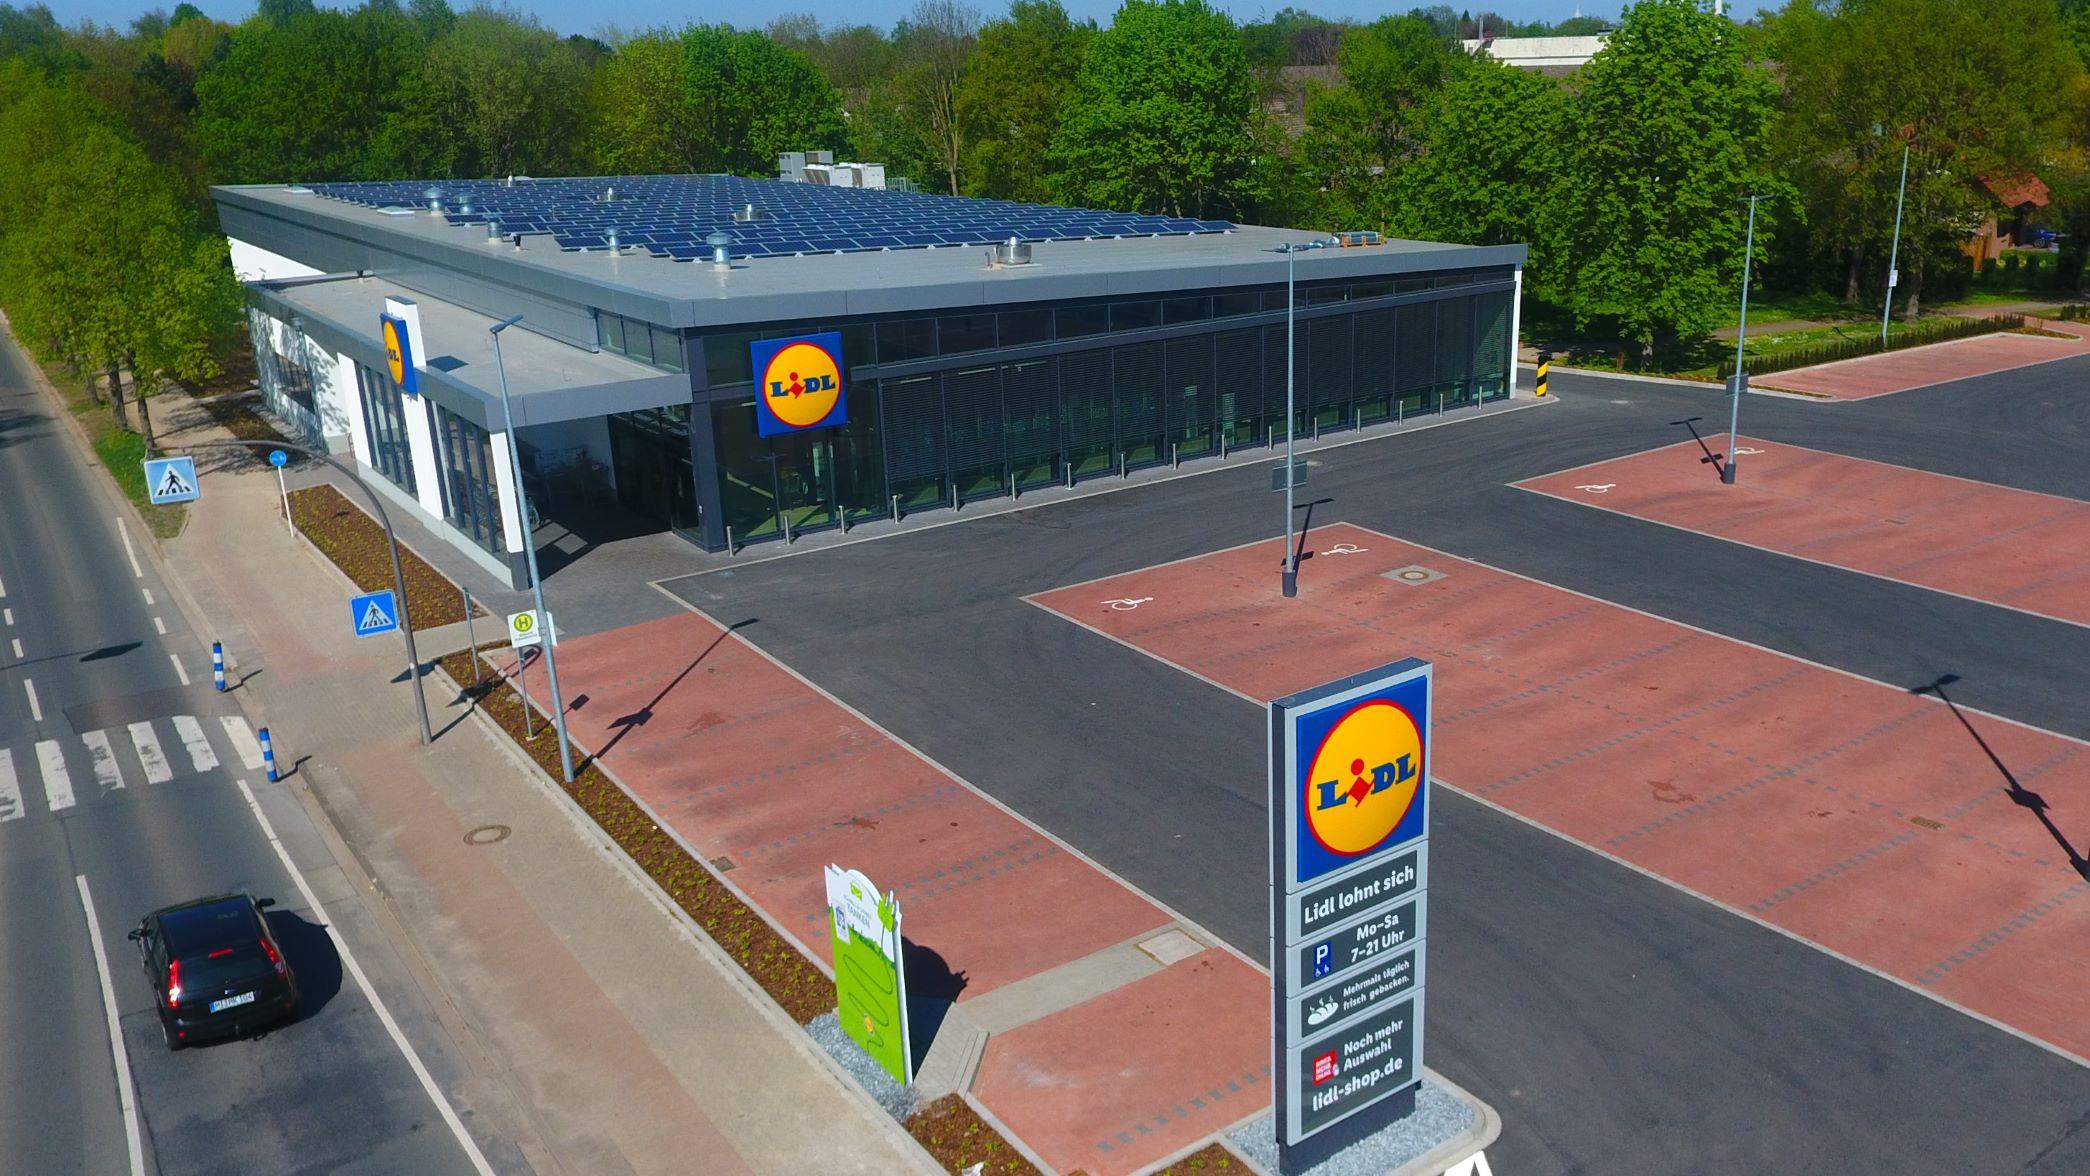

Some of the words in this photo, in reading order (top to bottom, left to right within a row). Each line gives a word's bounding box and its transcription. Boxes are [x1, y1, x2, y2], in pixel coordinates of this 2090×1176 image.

[770, 372, 836, 400] LIDL
[518, 616, 529, 629] H
[1317, 752, 1416, 811] LIDL
[1304, 896, 1335, 924] Lidl
[1338, 880, 1380, 909] lohnt
[1383, 865, 1414, 891] sich
[1316, 944, 1329, 965] P
[1381, 930, 1405, 948] Uhr
[1342, 974, 1381, 997] Mehrmals
[1383, 960, 1410, 978] täglich
[1342, 993, 1367, 1011] frisch
[1369, 975, 1410, 1000] gebacken.
[1343, 1032, 1373, 1056] Noch
[1374, 1019, 1404, 1042] mehr
[1343, 1038, 1392, 1072] Auswahl
[1312, 1057, 1403, 1111] lidl-shop.de
